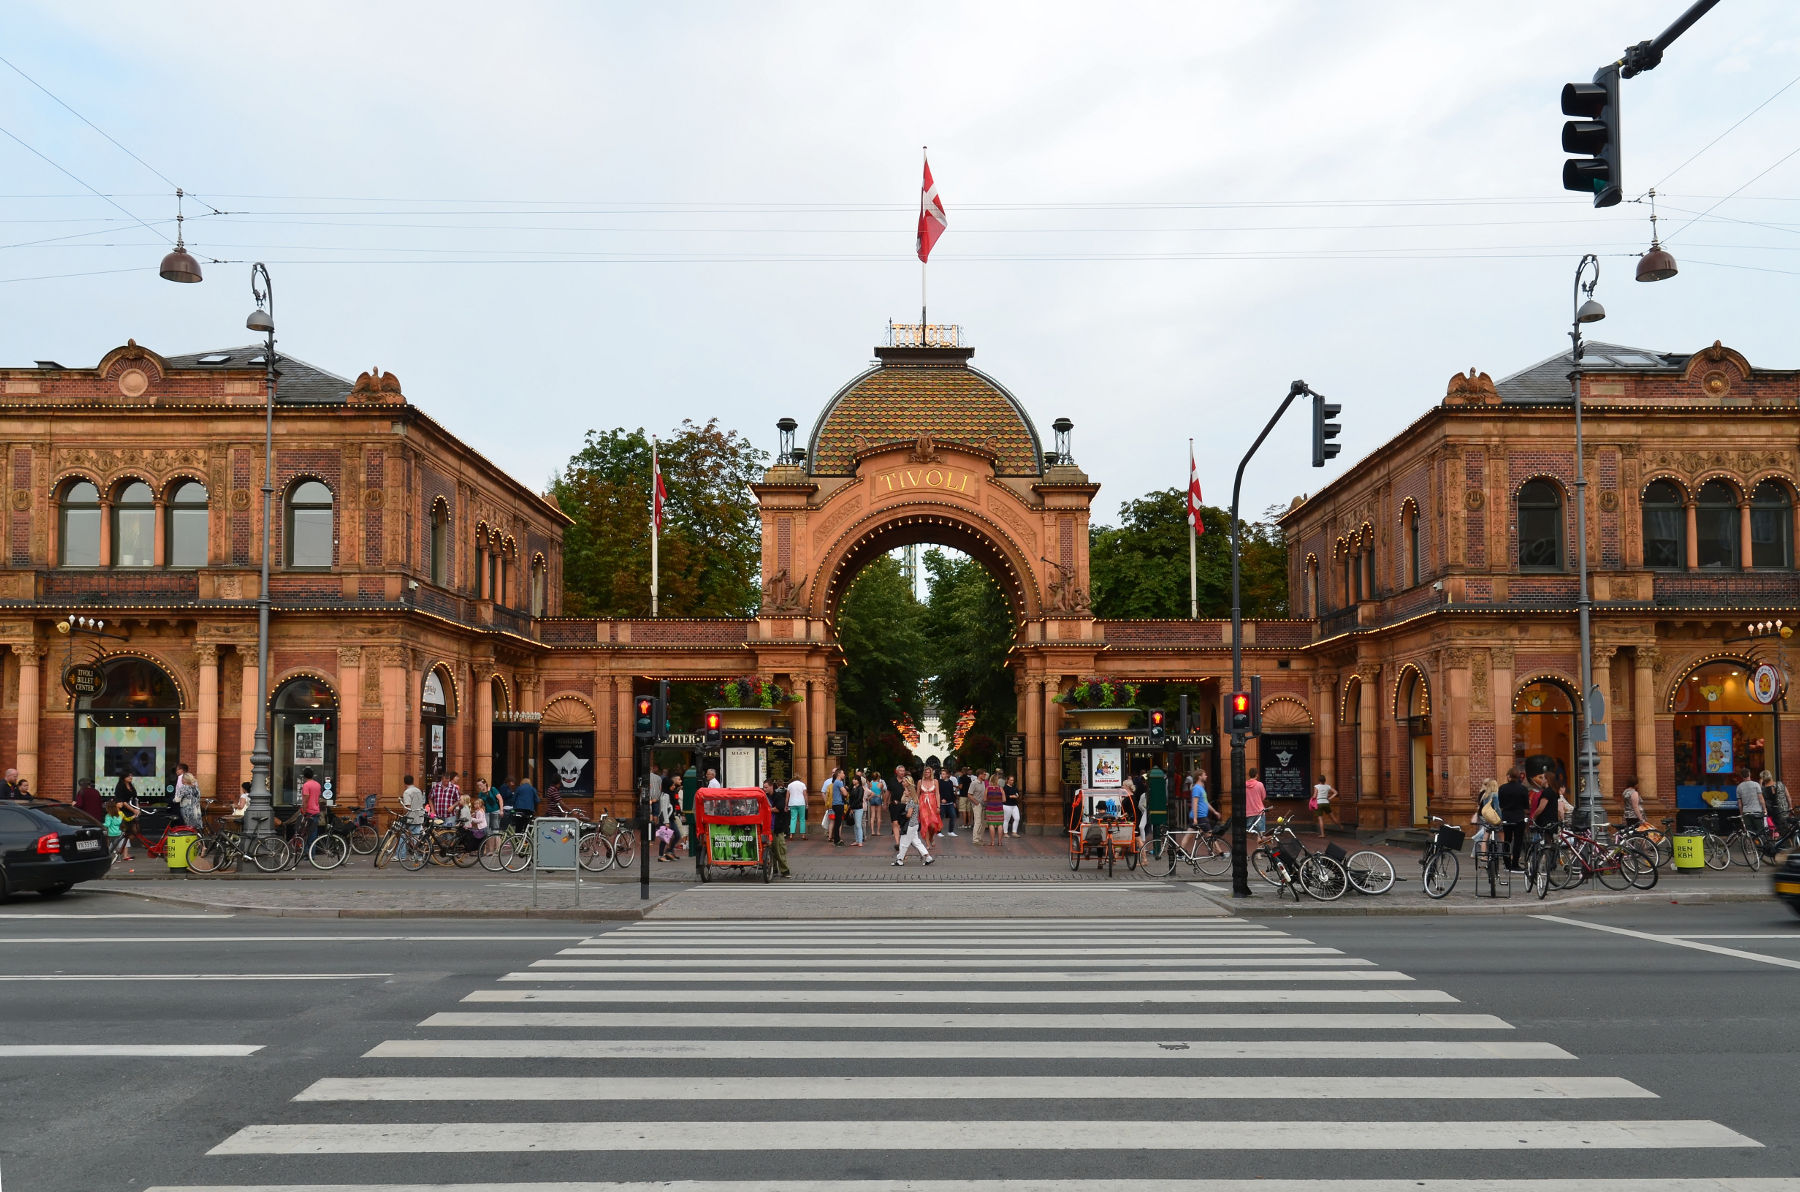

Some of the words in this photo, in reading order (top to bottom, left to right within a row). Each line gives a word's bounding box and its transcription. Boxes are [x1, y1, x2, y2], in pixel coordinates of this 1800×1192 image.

[892, 324, 956, 346] TIVOLI
[880, 469, 968, 491] TIVOLI
[1170, 735, 1212, 745] TIKETS
